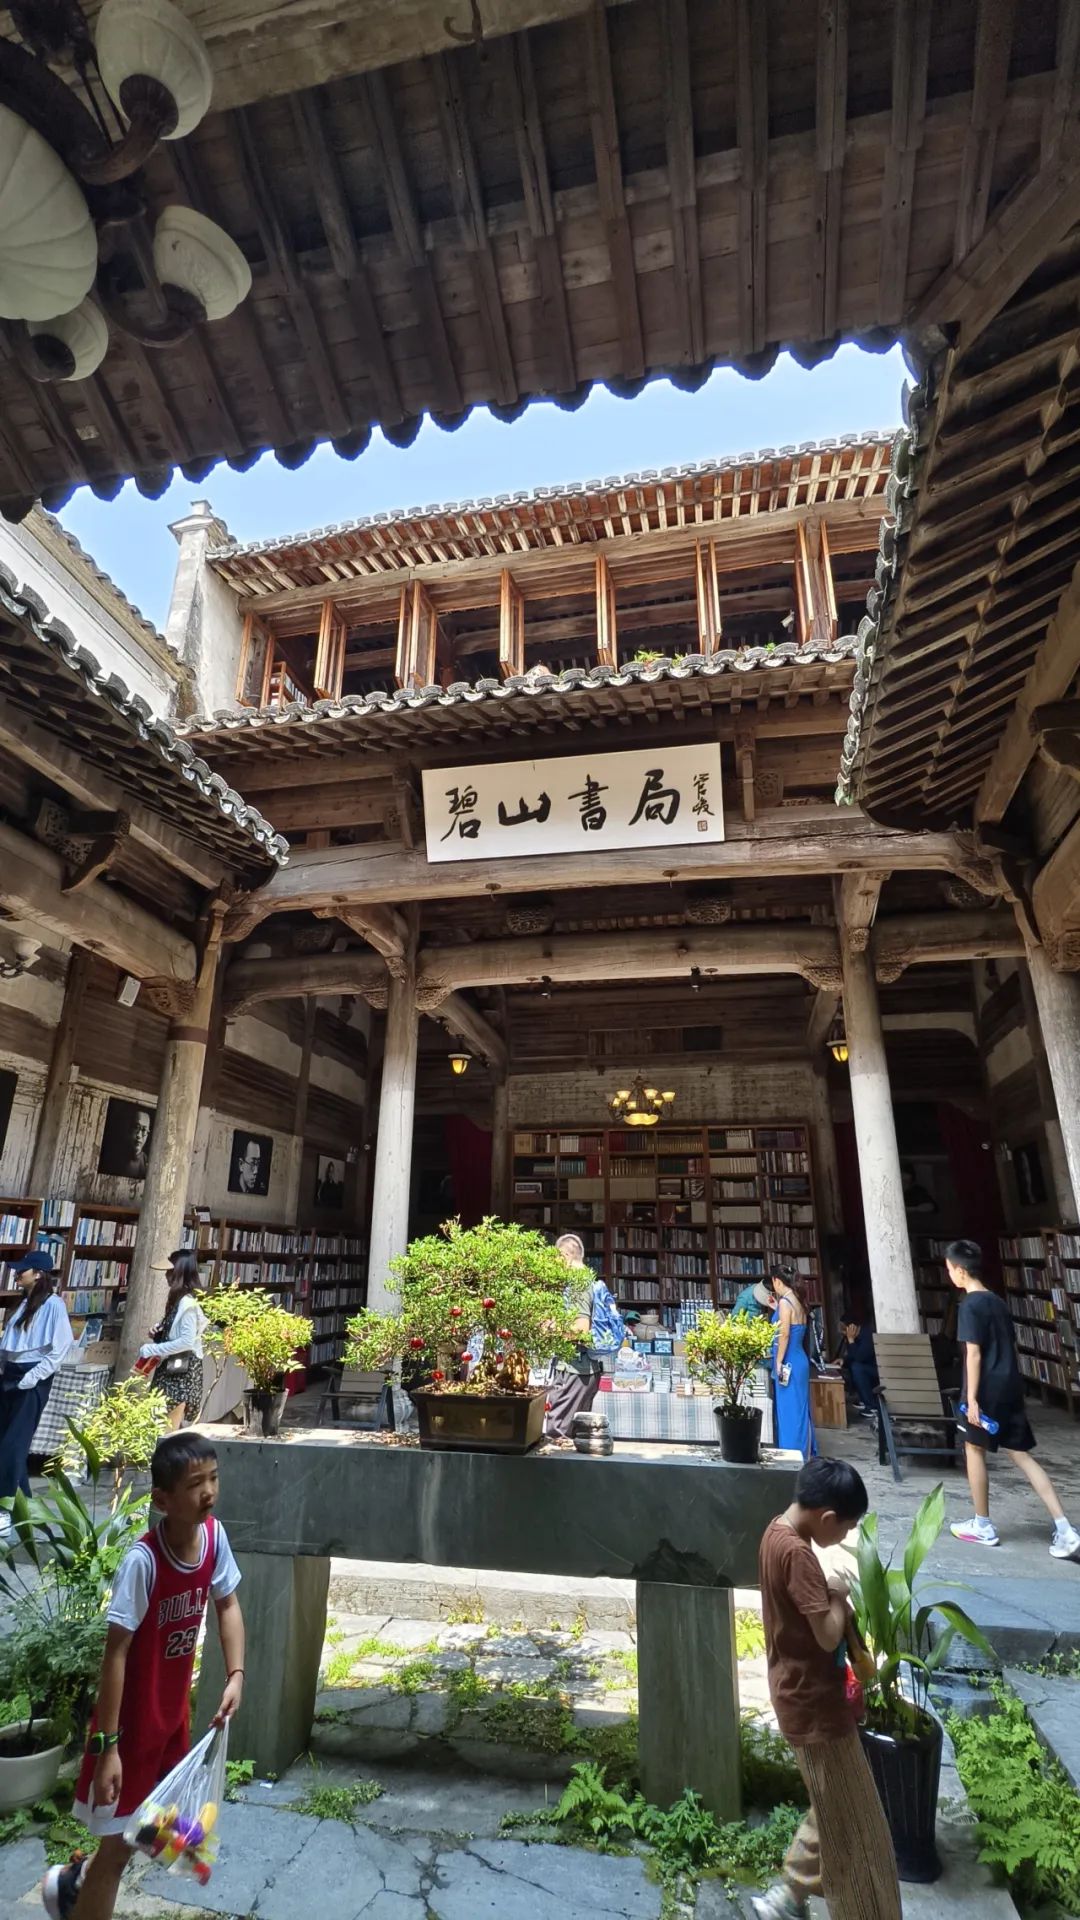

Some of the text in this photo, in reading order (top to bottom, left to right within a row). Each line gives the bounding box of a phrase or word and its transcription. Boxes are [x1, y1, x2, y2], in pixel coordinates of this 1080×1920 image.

[440, 768, 681, 842] 碧山書局
[165, 1625, 199, 1659] 23
